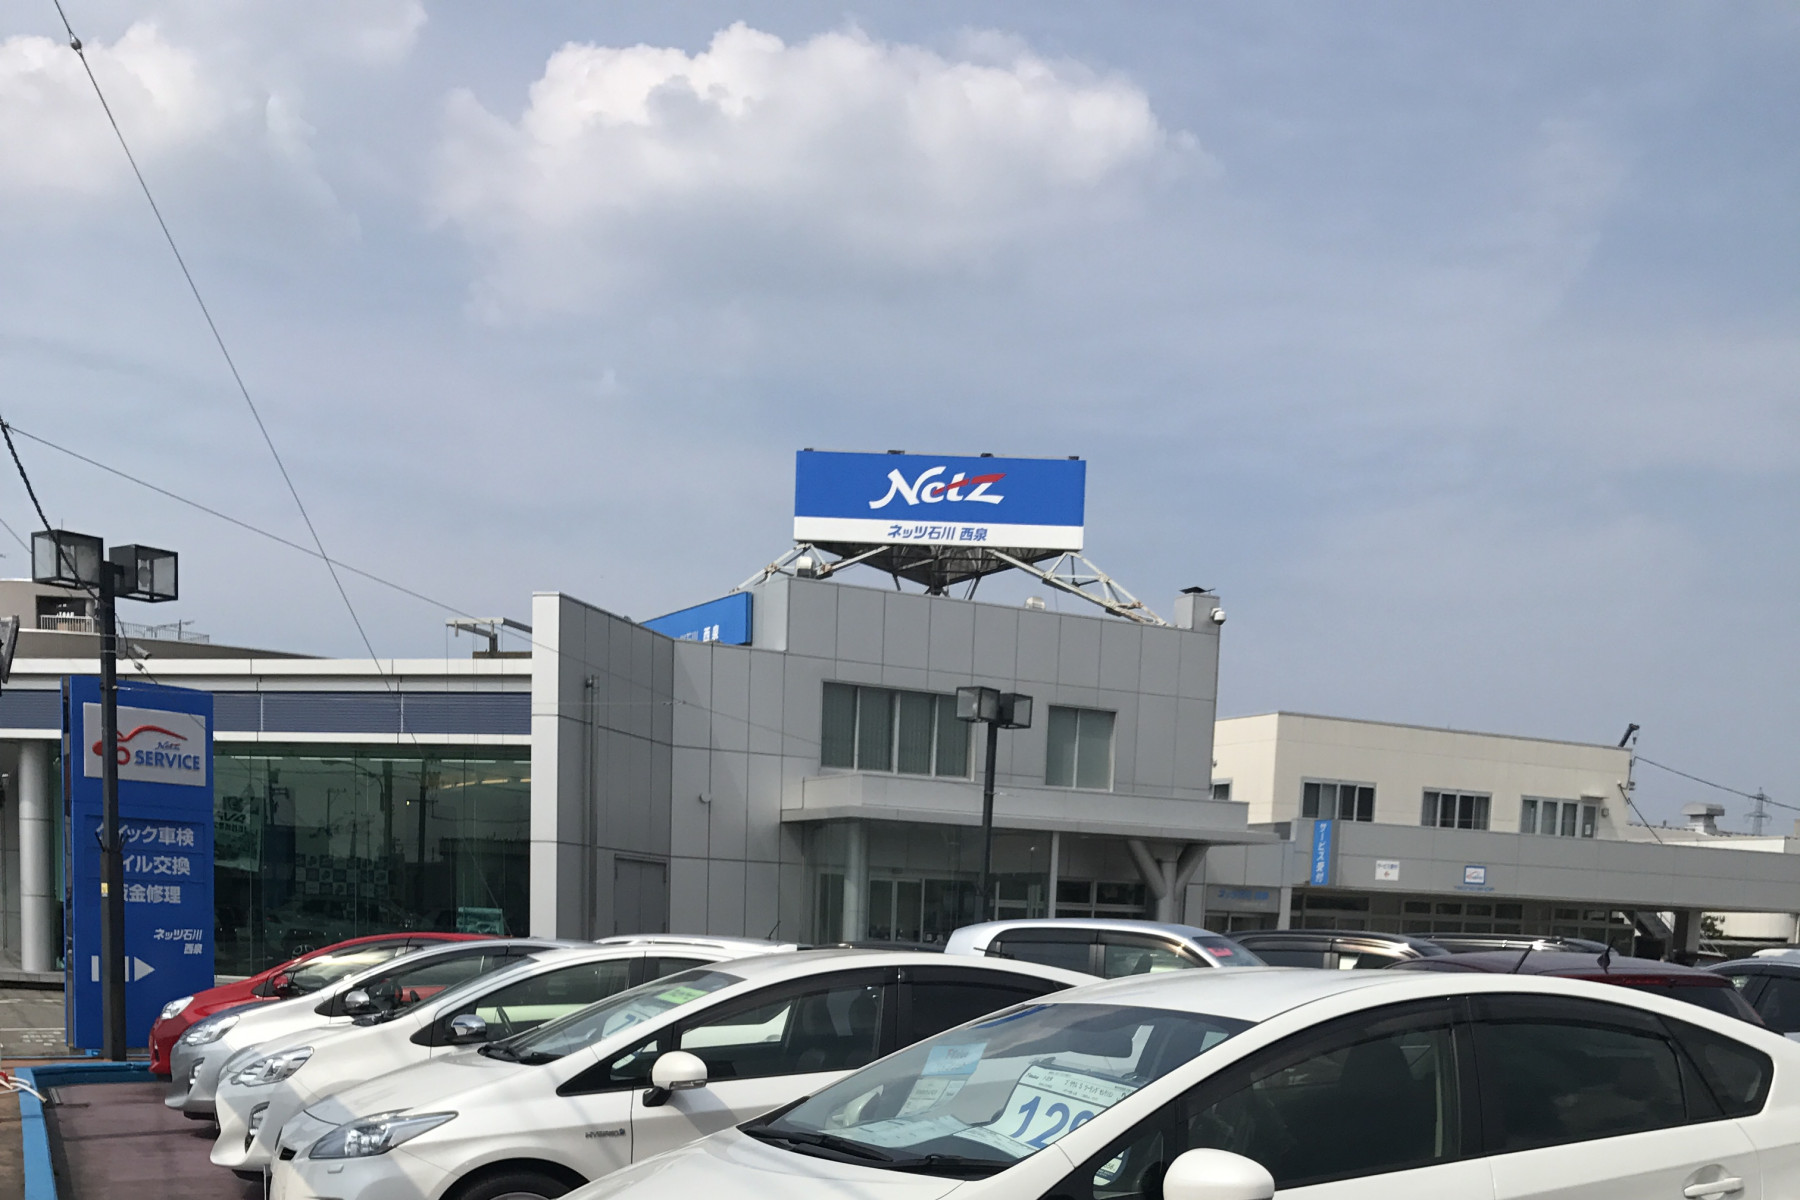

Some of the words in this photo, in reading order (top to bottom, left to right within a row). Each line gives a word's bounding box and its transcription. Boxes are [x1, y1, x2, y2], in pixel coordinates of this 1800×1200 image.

[868, 465, 1007, 510] Netz
[887, 524, 955, 540] ネッツ石川
[959, 527, 988, 542] 西泉
[134, 749, 200, 771] SERVICE
[153, 928, 203, 941] ネッツ石川
